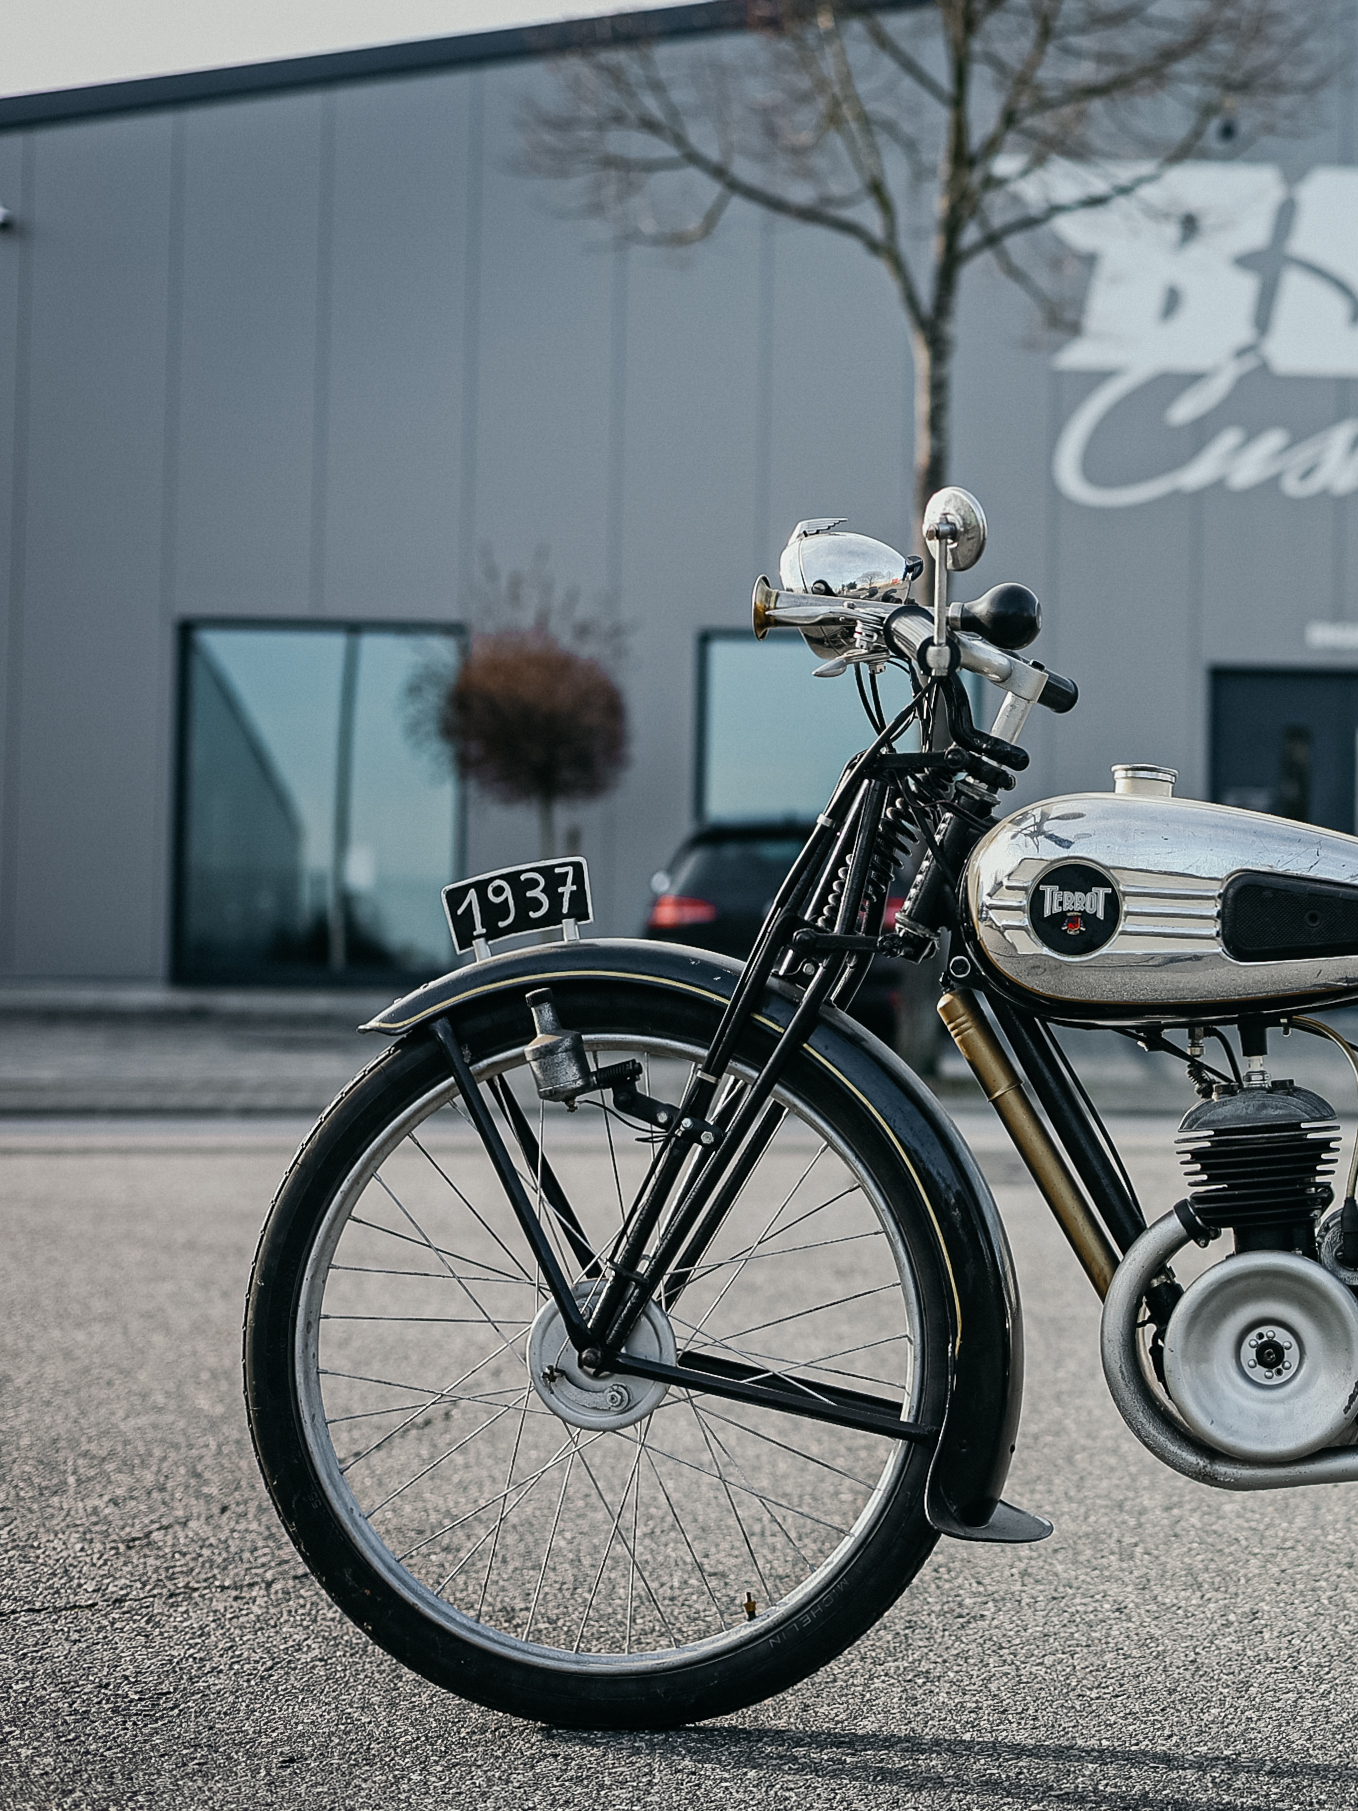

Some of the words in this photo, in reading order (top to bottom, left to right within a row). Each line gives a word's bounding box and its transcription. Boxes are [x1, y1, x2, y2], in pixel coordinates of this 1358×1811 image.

[456, 866, 577, 936] 1937
[1039, 884, 1112, 920] TERROT
[768, 1577, 849, 1648] MICHELIN
